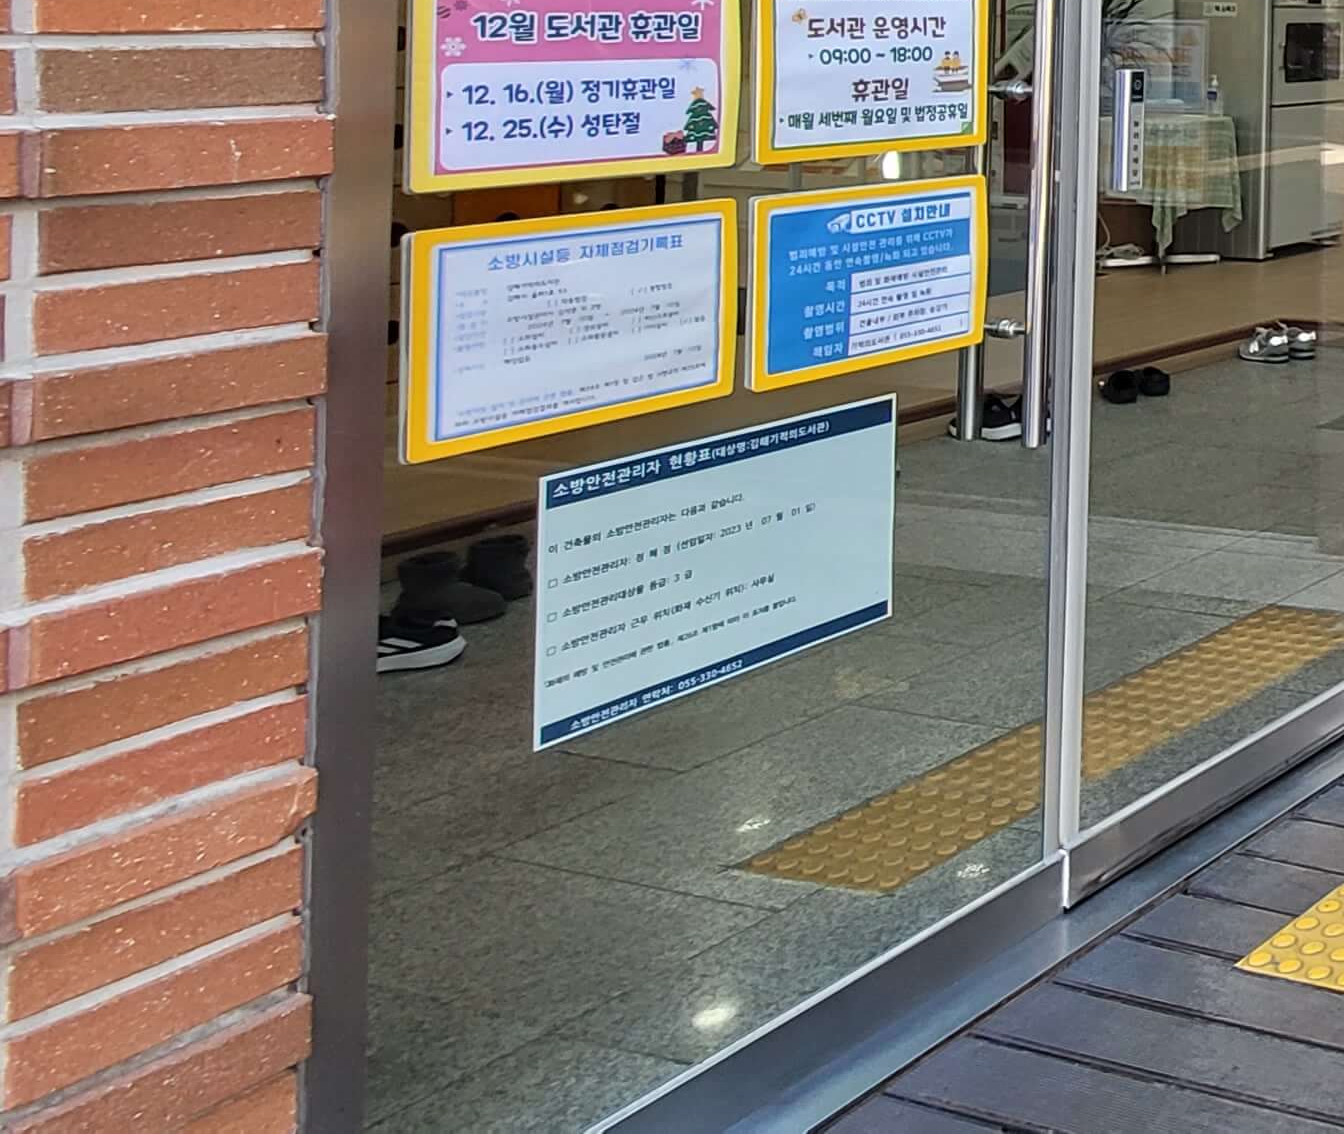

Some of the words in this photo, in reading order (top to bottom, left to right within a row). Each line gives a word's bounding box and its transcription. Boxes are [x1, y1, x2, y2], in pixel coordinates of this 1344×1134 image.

[472, 13, 537, 42] 12월
[546, 14, 622, 42] 도서관
[629, 12, 702, 41] 휴관일
[807, 16, 865, 40] 도서관
[872, 15, 947, 41] 운영시간
[819, 47, 872, 65] 09:00
[889, 46, 934, 63] 18:00
[462, 84, 496, 107] 12.
[503, 79, 574, 106] 16.(월)
[581, 76, 676, 103] 정기휴관일
[851, 78, 910, 103] 휴관일
[462, 120, 496, 143] 12.
[503, 115, 574, 140] 25.(수)
[581, 112, 642, 138] 성탄절
[787, 112, 815, 131] 매월
[818, 110, 858, 129] 세번째
[862, 108, 898, 126] 월요일
[901, 106, 912, 123] 및
[915, 102, 969, 123] 법정공휴일
[855, 209, 897, 229] CCTV
[901, 202, 951, 224] 설치안내
[487, 247, 572, 272] 소방시설등
[579, 233, 685, 260] 자체점검기록표
[789, 260, 822, 277] 24시간
[803, 301, 846, 319] 촬영시간
[552, 458, 662, 499] 소방안전관리자
[548, 544, 558, 555] 이
[563, 531, 602, 551] 건축물의
[605, 511, 678, 539] 소방안전관리자는
[680, 502, 706, 518] 다음과
[711, 492, 745, 510] 같습니다.
[562, 556, 632, 584] 소방안전관리자:
[562, 584, 645, 618] 소방안전관리대상물
[673, 572, 681, 583] 3
[684, 569, 693, 580] 급
[560, 622, 627, 652] 소방안전관리자
[630, 614, 649, 629] 근무
[695, 591, 721, 608] 수신기
[751, 572, 775, 589] 사무실
[569, 696, 639, 731] 소방안전관리자
